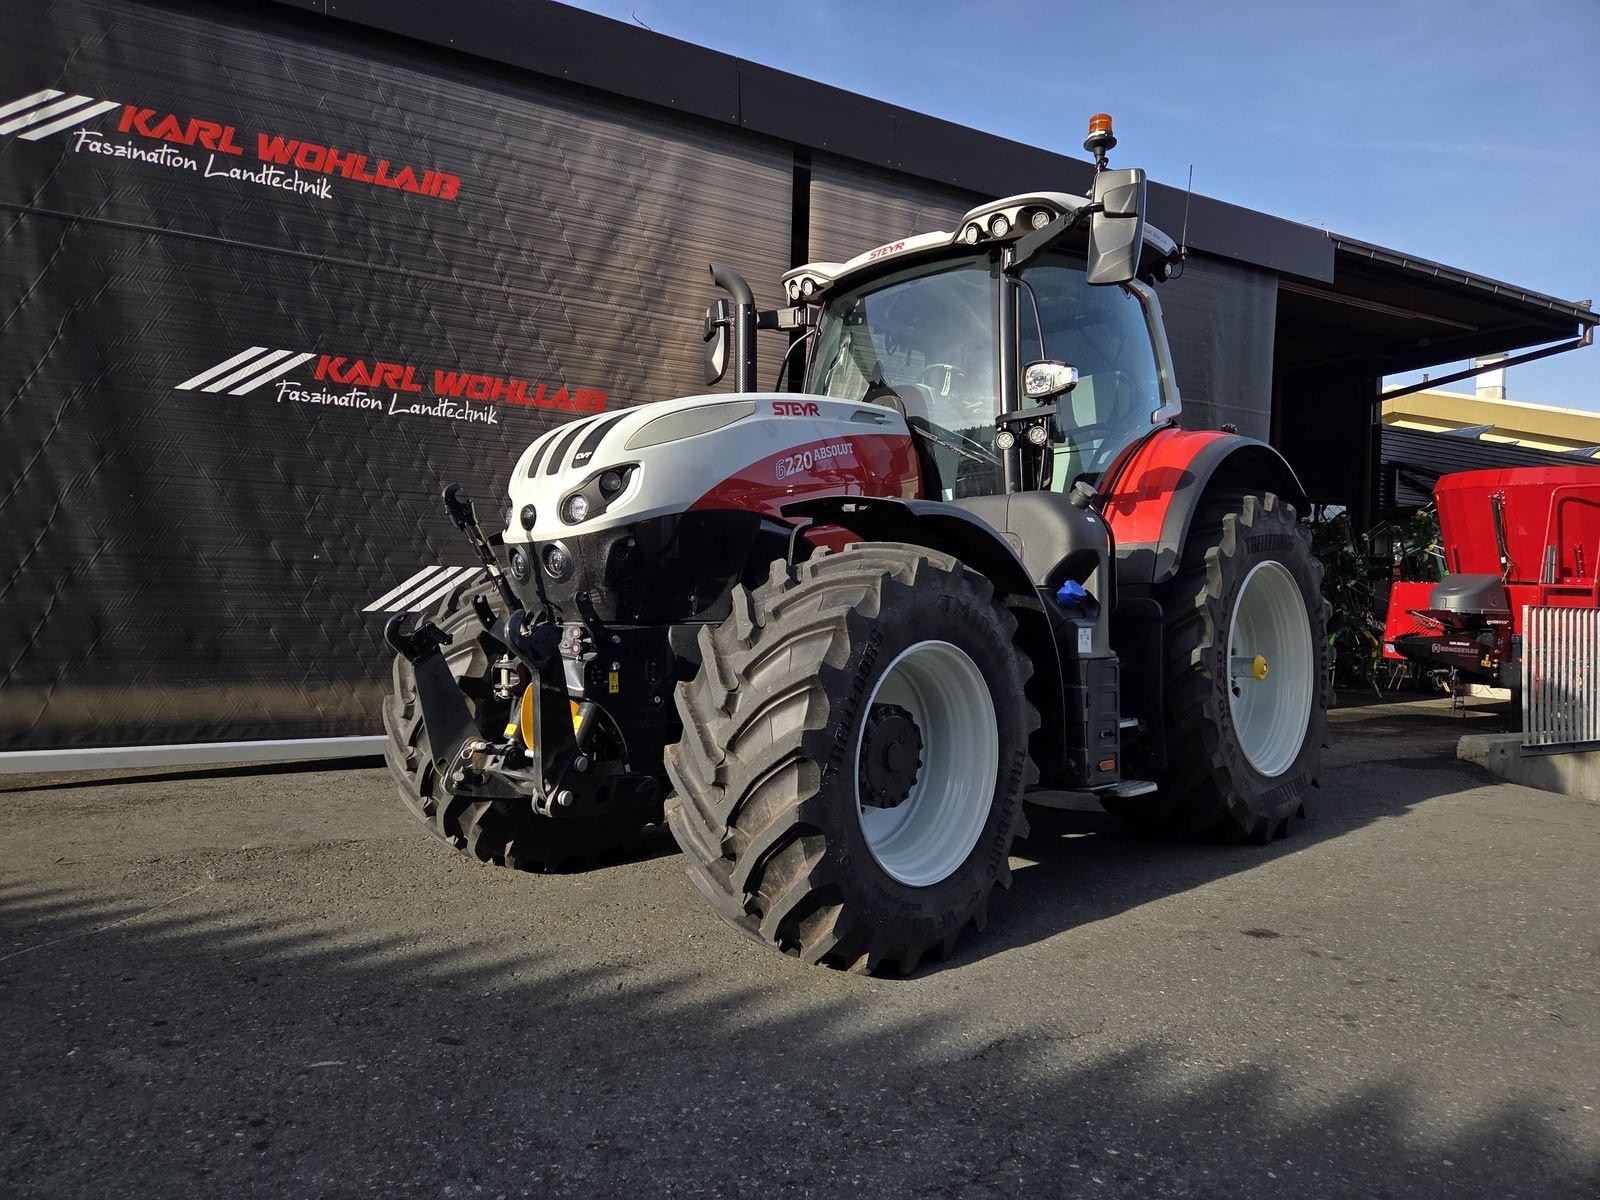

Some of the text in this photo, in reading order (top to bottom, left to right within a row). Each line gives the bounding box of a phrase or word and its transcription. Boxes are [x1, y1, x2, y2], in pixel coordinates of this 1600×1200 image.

[73, 128, 333, 199] Faszination Landtechnik
[118, 105, 461, 200] KARL WOHLLAIB
[869, 242, 905, 260] STEYR
[275, 380, 498, 424] Faszination Landtechnik
[314, 355, 608, 413] KARL WOHLLAIB
[772, 401, 821, 416] STEYR
[575, 451, 592, 460] CVT
[776, 451, 813, 480] 6220
[814, 443, 853, 461] ABSOLUT
